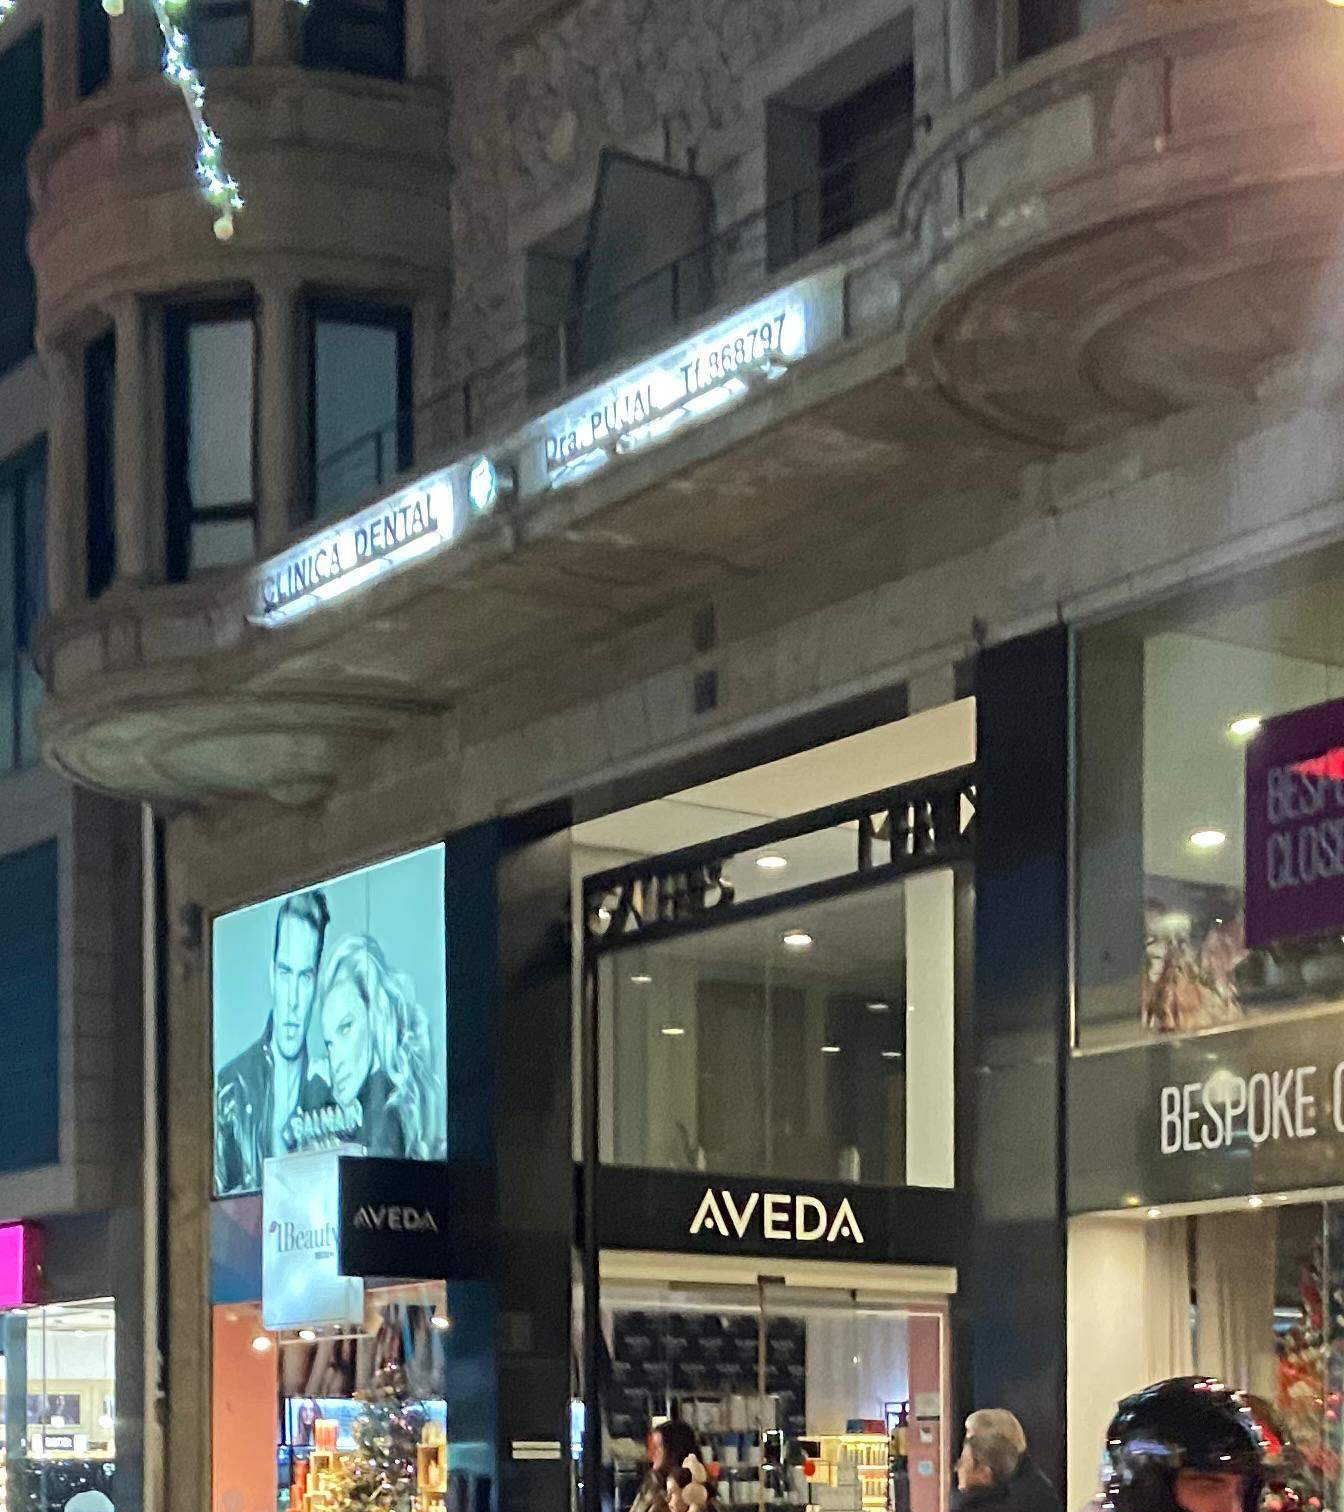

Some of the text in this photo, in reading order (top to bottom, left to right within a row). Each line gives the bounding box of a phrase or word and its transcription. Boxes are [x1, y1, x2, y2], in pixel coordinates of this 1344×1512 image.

[354, 494, 438, 558] DENTAL
[1160, 1066, 1317, 1154] BESPOKE
[352, 1204, 439, 1232] AVEDA
[689, 1188, 865, 1243] AVEDA
